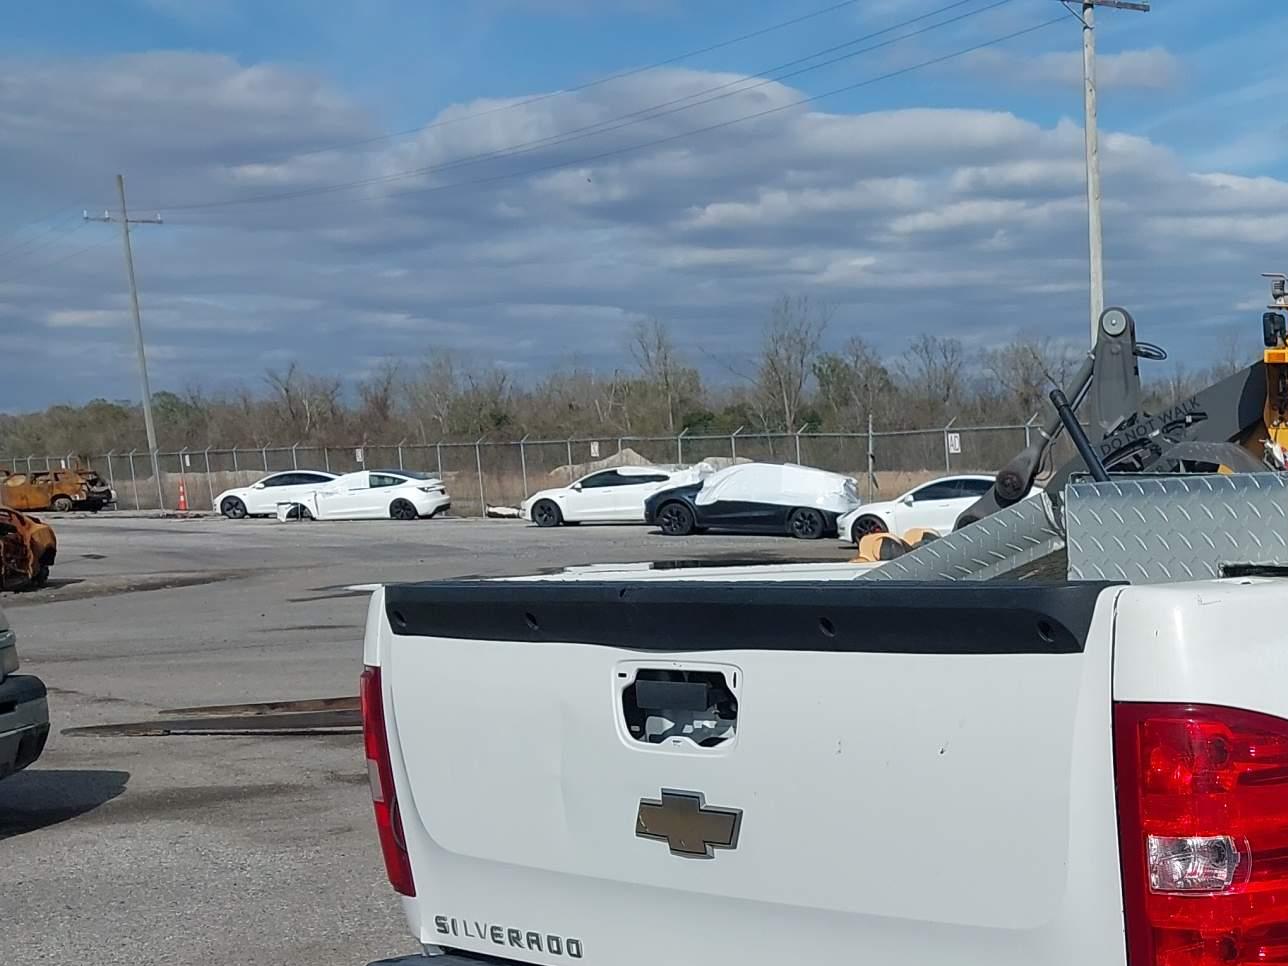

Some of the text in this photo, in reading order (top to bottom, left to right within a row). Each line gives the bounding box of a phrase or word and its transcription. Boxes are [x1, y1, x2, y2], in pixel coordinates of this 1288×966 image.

[1100, 396, 1201, 456] DO NOT WALK
[434, 915, 583, 959] SILVERADO
